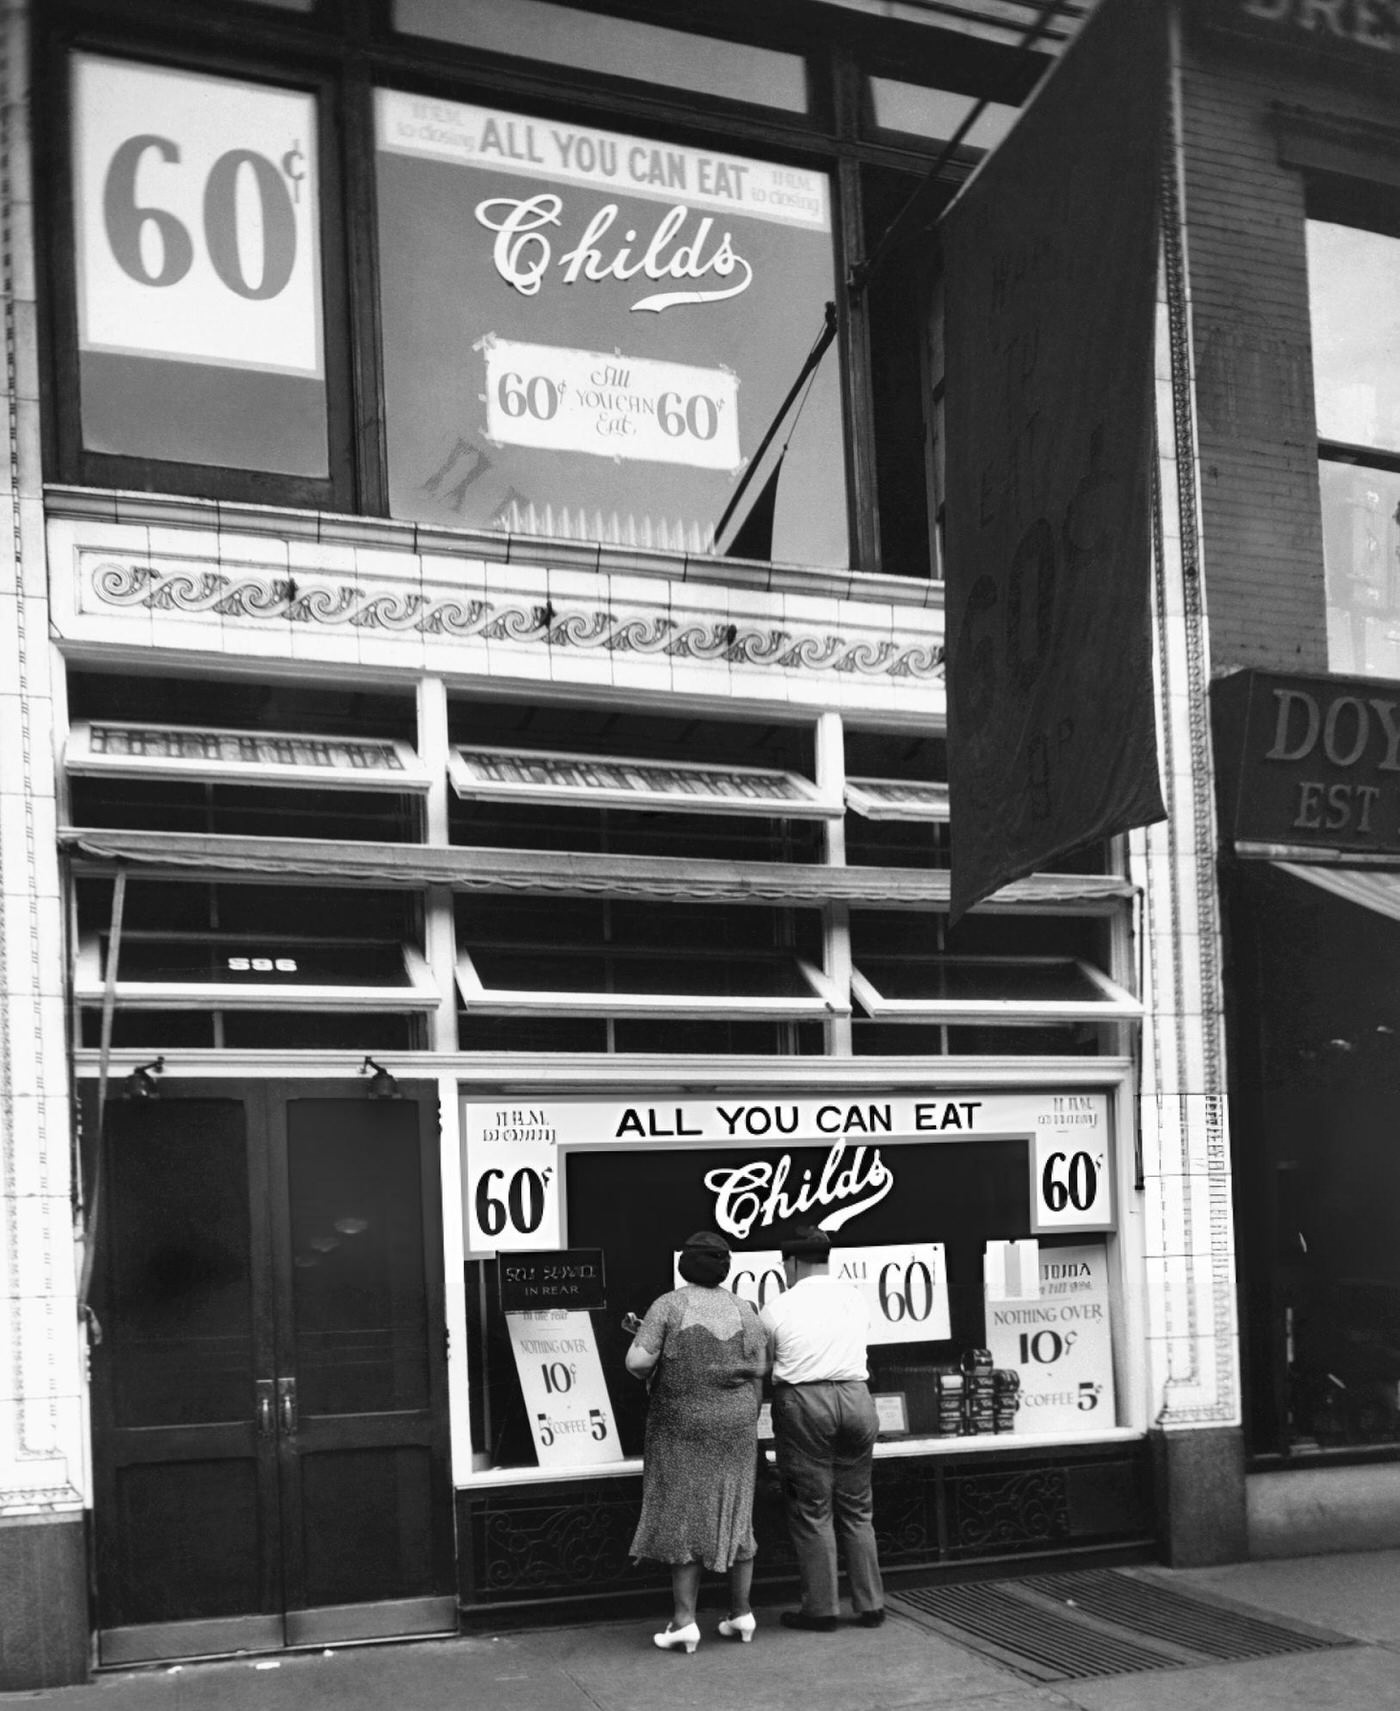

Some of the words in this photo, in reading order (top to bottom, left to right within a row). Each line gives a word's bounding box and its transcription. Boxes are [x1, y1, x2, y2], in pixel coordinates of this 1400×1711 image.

[479, 117, 543, 164] ALL
[552, 130, 617, 176] YOU
[628, 146, 688, 190] CAN
[698, 158, 749, 200] EAT
[475, 194, 752, 312] Childs
[590, 366, 631, 388] All
[615, 1108, 703, 1137] ALL
[716, 1106, 799, 1135] YOU
[816, 1104, 893, 1133] CAN
[914, 1102, 982, 1130] EAT
[704, 1137, 894, 1239] Childs
[525, 1286, 539, 1297] IN
[542, 1285, 579, 1296] REAR
[994, 1307, 1057, 1326] NOTHING
[1060, 1303, 1103, 1322] OVER
[520, 1340, 560, 1355] NOTHING
[560, 1338, 588, 1354] OVER
[1024, 1392, 1073, 1408] COFFEE
[553, 1420, 587, 1434] COFFEE
